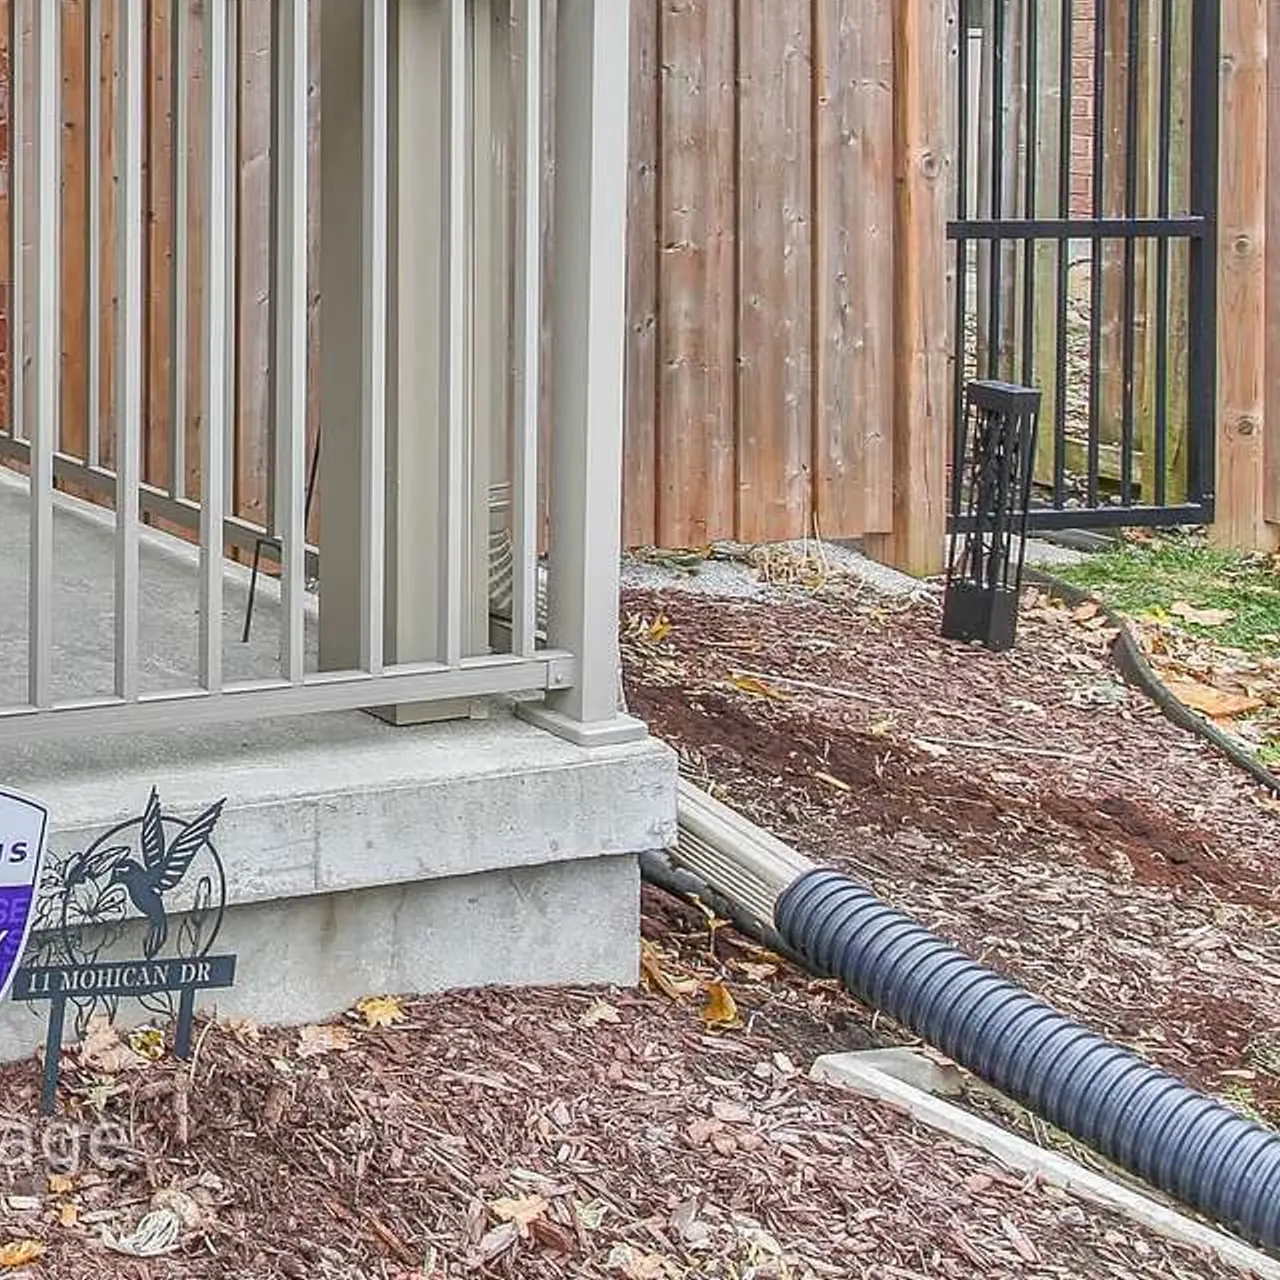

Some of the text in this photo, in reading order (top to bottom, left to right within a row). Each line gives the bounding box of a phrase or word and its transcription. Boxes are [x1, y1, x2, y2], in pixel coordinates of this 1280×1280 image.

[28, 962, 211, 993] 11 MOHICAN DR
